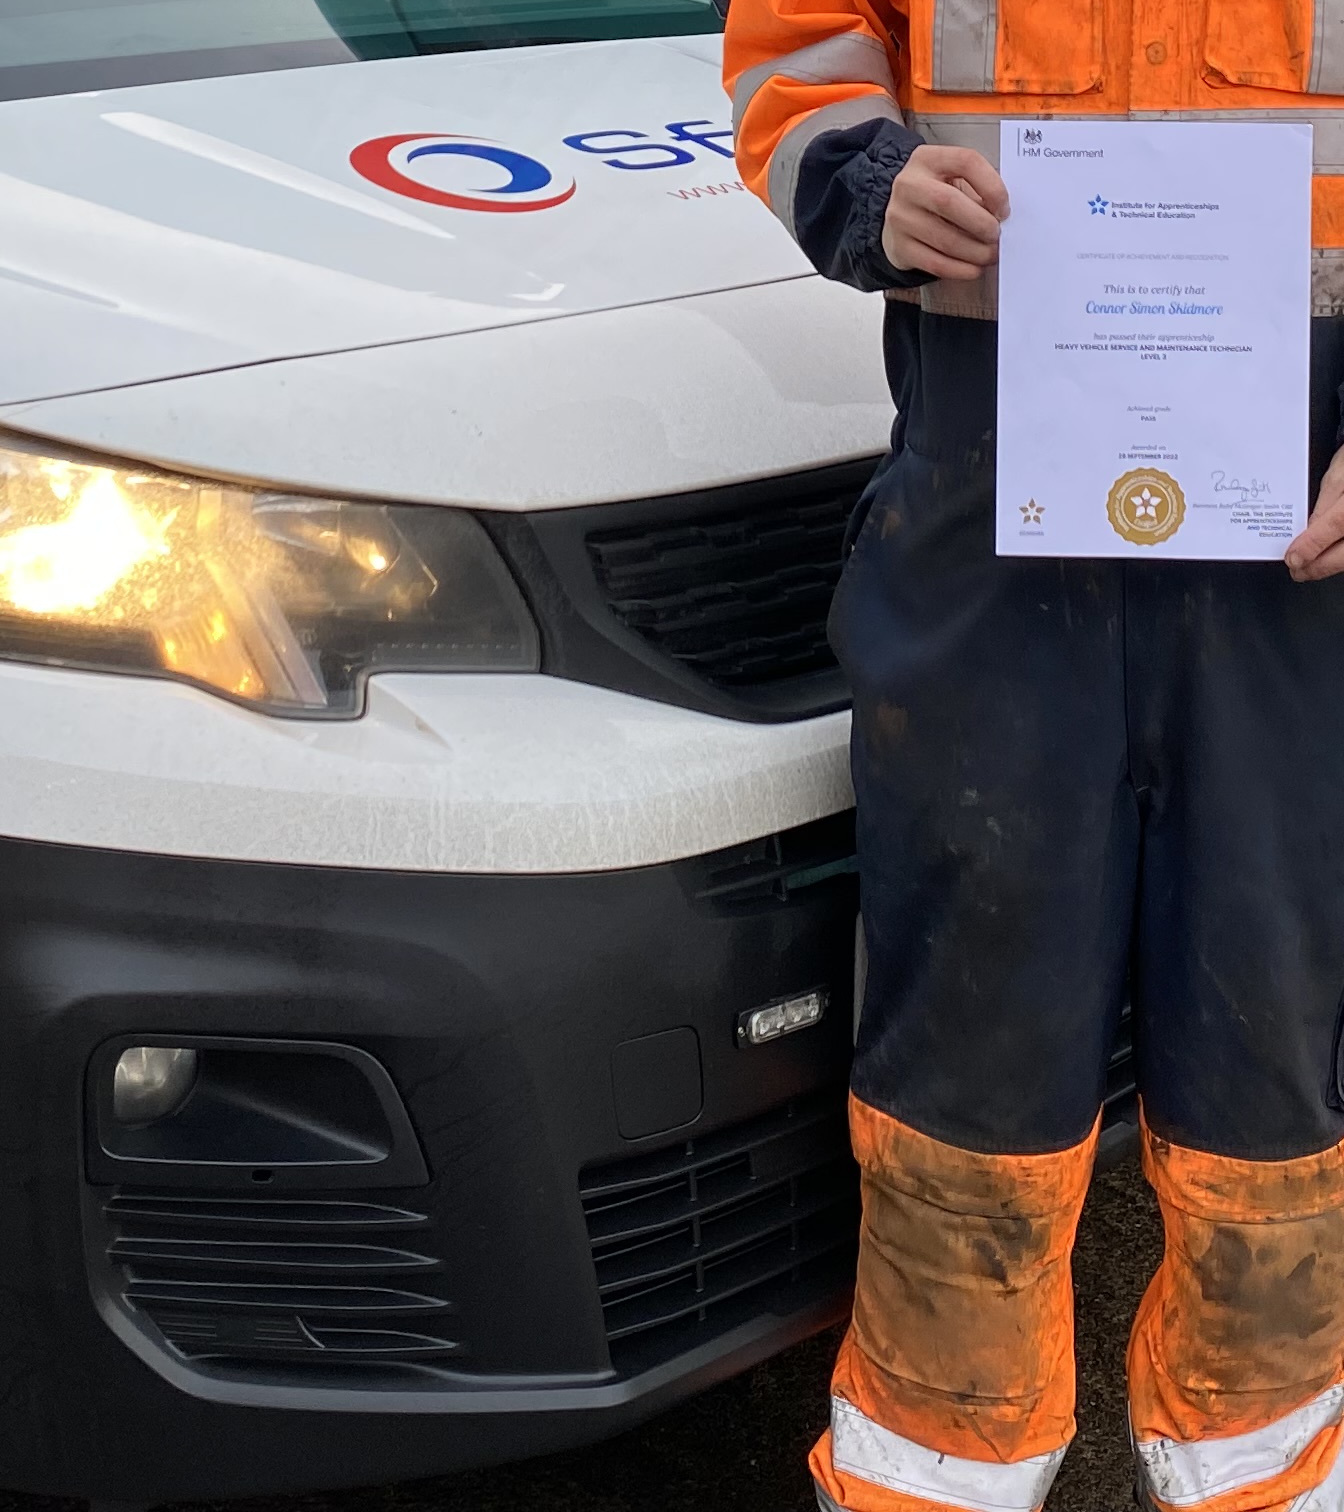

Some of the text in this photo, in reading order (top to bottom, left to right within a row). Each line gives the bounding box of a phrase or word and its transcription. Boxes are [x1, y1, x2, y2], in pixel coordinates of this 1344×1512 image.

[562, 119, 735, 170] sf
[1023, 147, 1104, 158] HM Government
[1157, 202, 1220, 211] Apprenticeships
[1157, 211, 1196, 219] Education
[1103, 284, 1206, 296] This is to certify that
[1085, 300, 1224, 316] Connor Simon Skidmore
[1080, 343, 1108, 351] VEHICLE
[1156, 344, 1208, 352] MAINTENANCE
